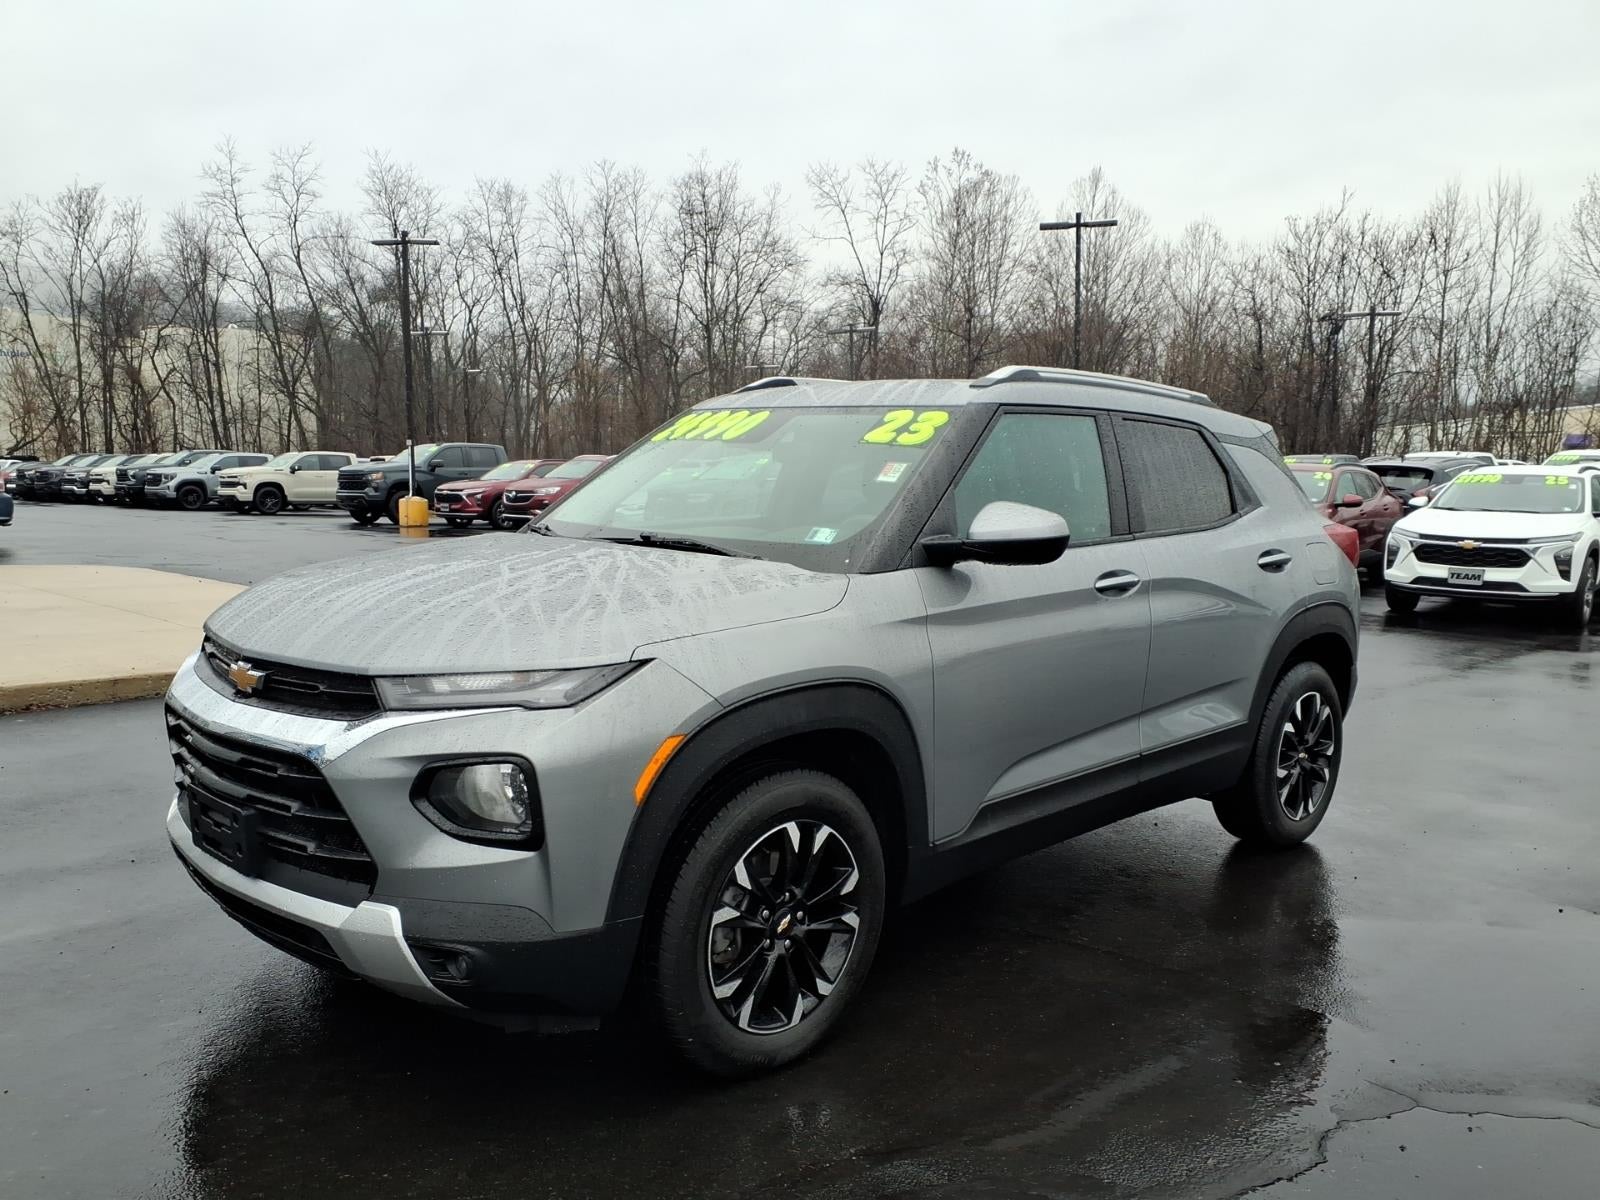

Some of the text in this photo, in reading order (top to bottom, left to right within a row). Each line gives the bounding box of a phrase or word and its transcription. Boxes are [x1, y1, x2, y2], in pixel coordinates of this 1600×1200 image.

[862, 408, 950, 446] 23
[1545, 475, 1569, 486] 25
[1450, 572, 1482, 581] TEAM
